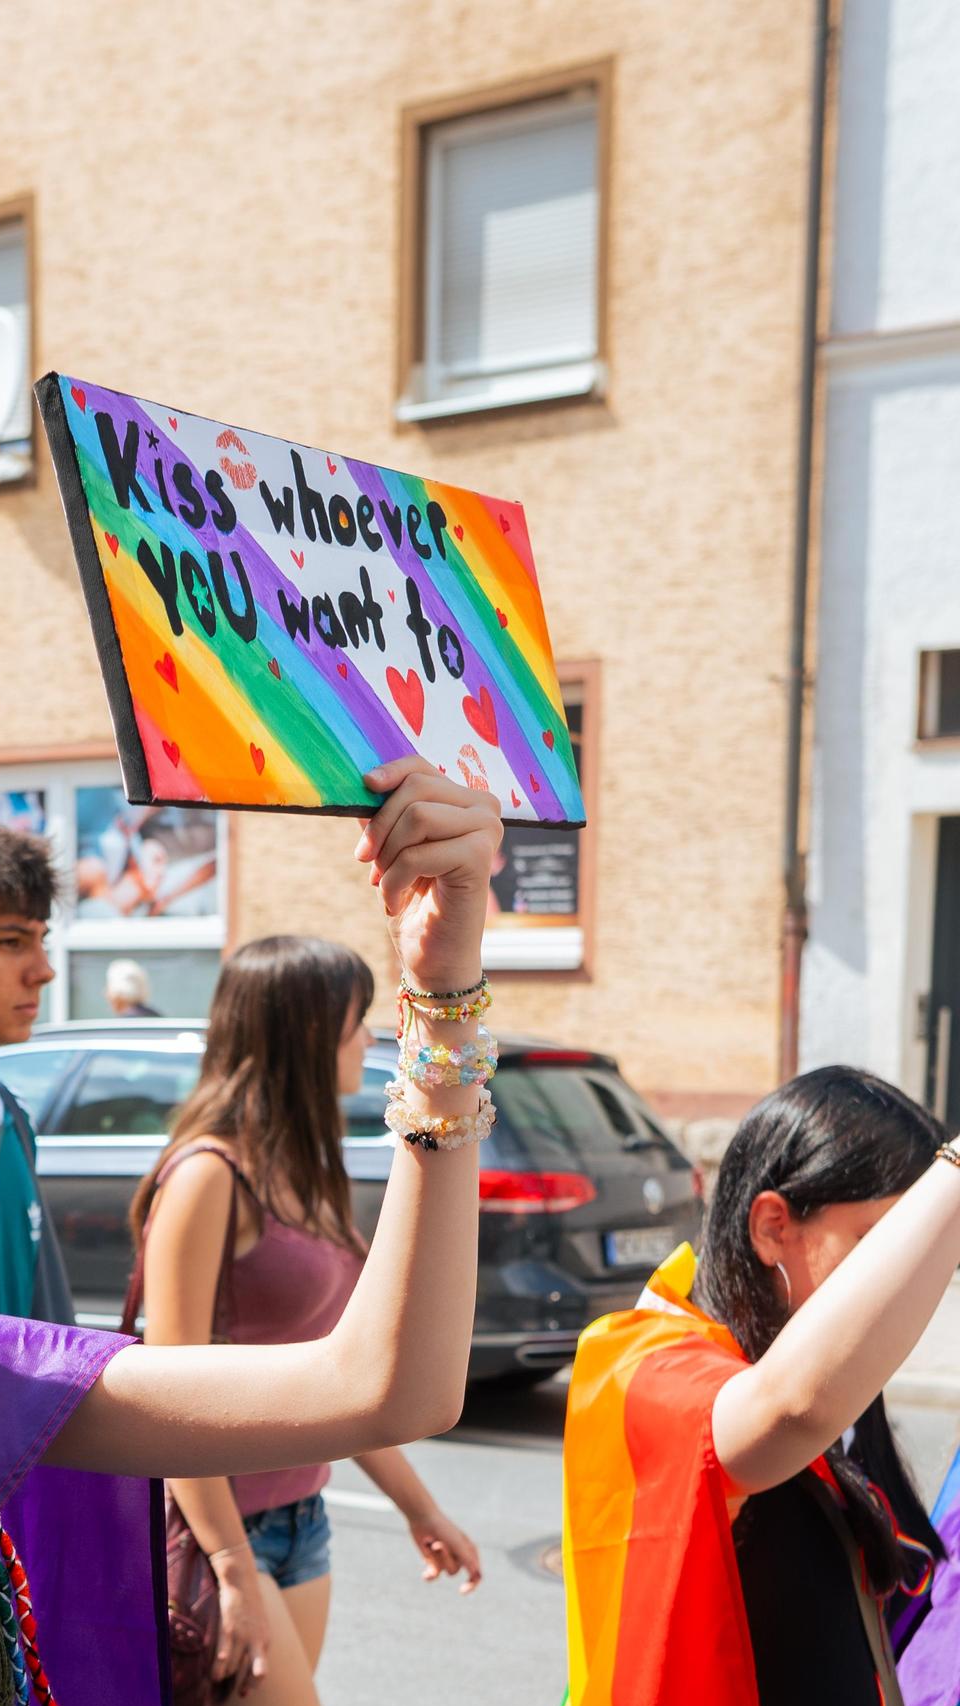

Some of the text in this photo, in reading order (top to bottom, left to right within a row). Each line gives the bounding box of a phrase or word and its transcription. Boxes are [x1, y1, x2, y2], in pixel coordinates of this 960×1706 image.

[95, 411, 448, 560] Kiss whoever
[137, 538, 465, 684] YOU want to
